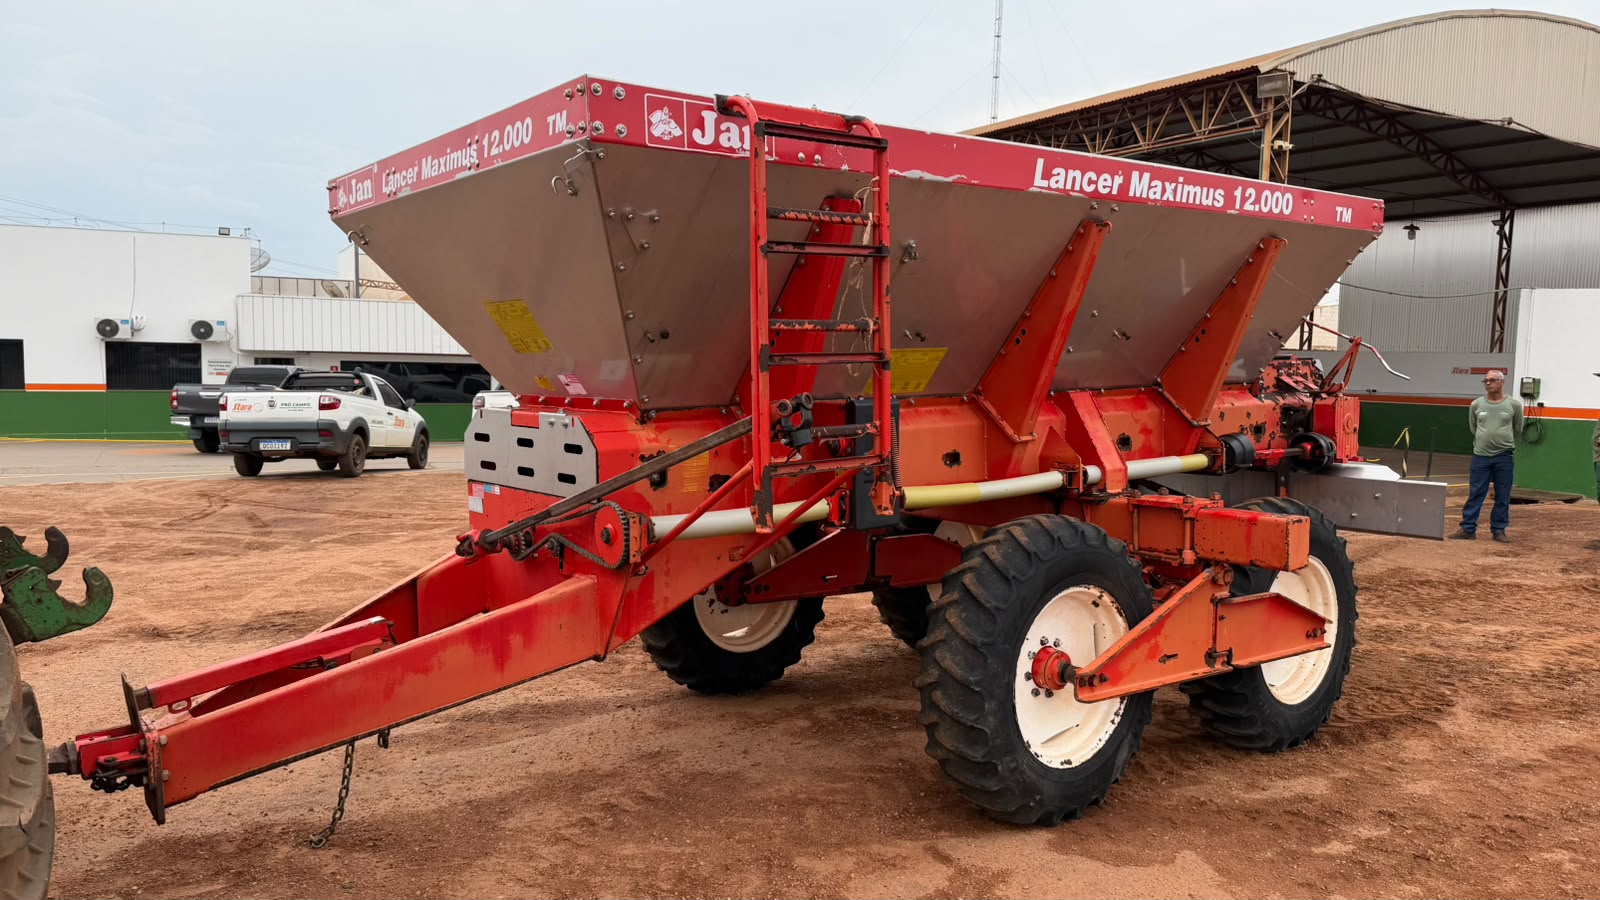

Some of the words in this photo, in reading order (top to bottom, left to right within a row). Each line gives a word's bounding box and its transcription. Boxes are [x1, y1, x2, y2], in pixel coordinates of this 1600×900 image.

[547, 110, 567, 137] TM
[382, 165, 418, 194] Lancer
[421, 144, 477, 181] Maximus
[482, 116, 533, 158] 12.000
[349, 178, 373, 205] Jan
[1033, 158, 1122, 195] Lancer
[1128, 170, 1224, 208] Maximus
[1233, 186, 1293, 216] 12.000
[1335, 206, 1352, 224] TM
[232, 403, 253, 411] Stara
